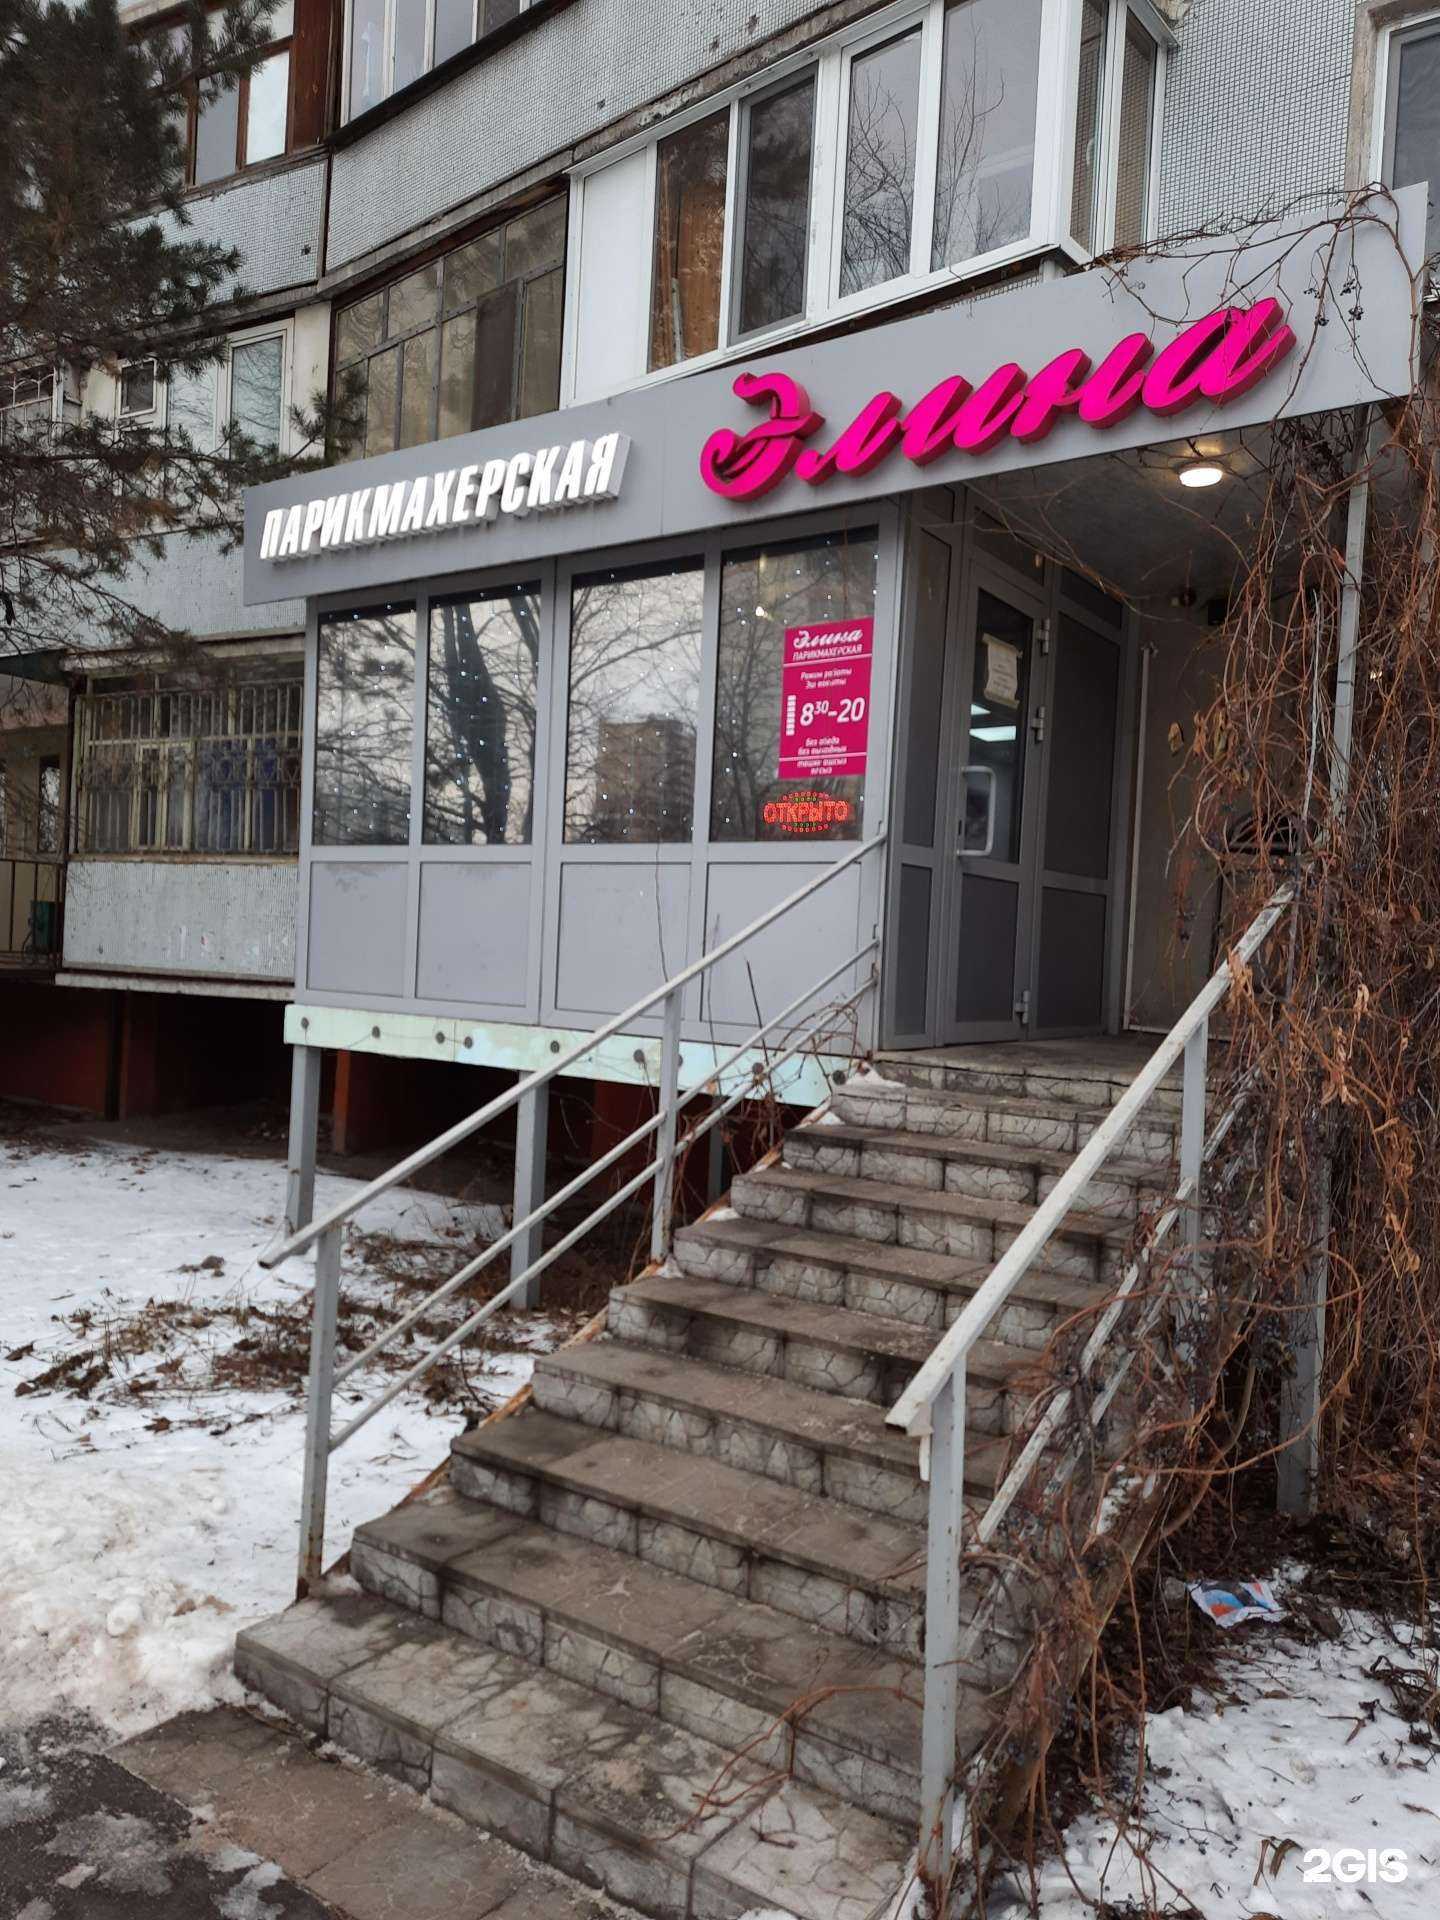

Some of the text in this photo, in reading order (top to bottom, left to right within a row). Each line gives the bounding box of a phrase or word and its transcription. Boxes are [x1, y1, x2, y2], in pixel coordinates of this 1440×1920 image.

[700, 297, 1297, 500] Элина
[260, 432, 631, 562] ПАРИКМАХЕРСКАЯ
[793, 629, 863, 649] Элина
[792, 643, 863, 661] ПАРИКМАХЕРСКАЯ
[764, 800, 849, 823] ОТКРЫТО
